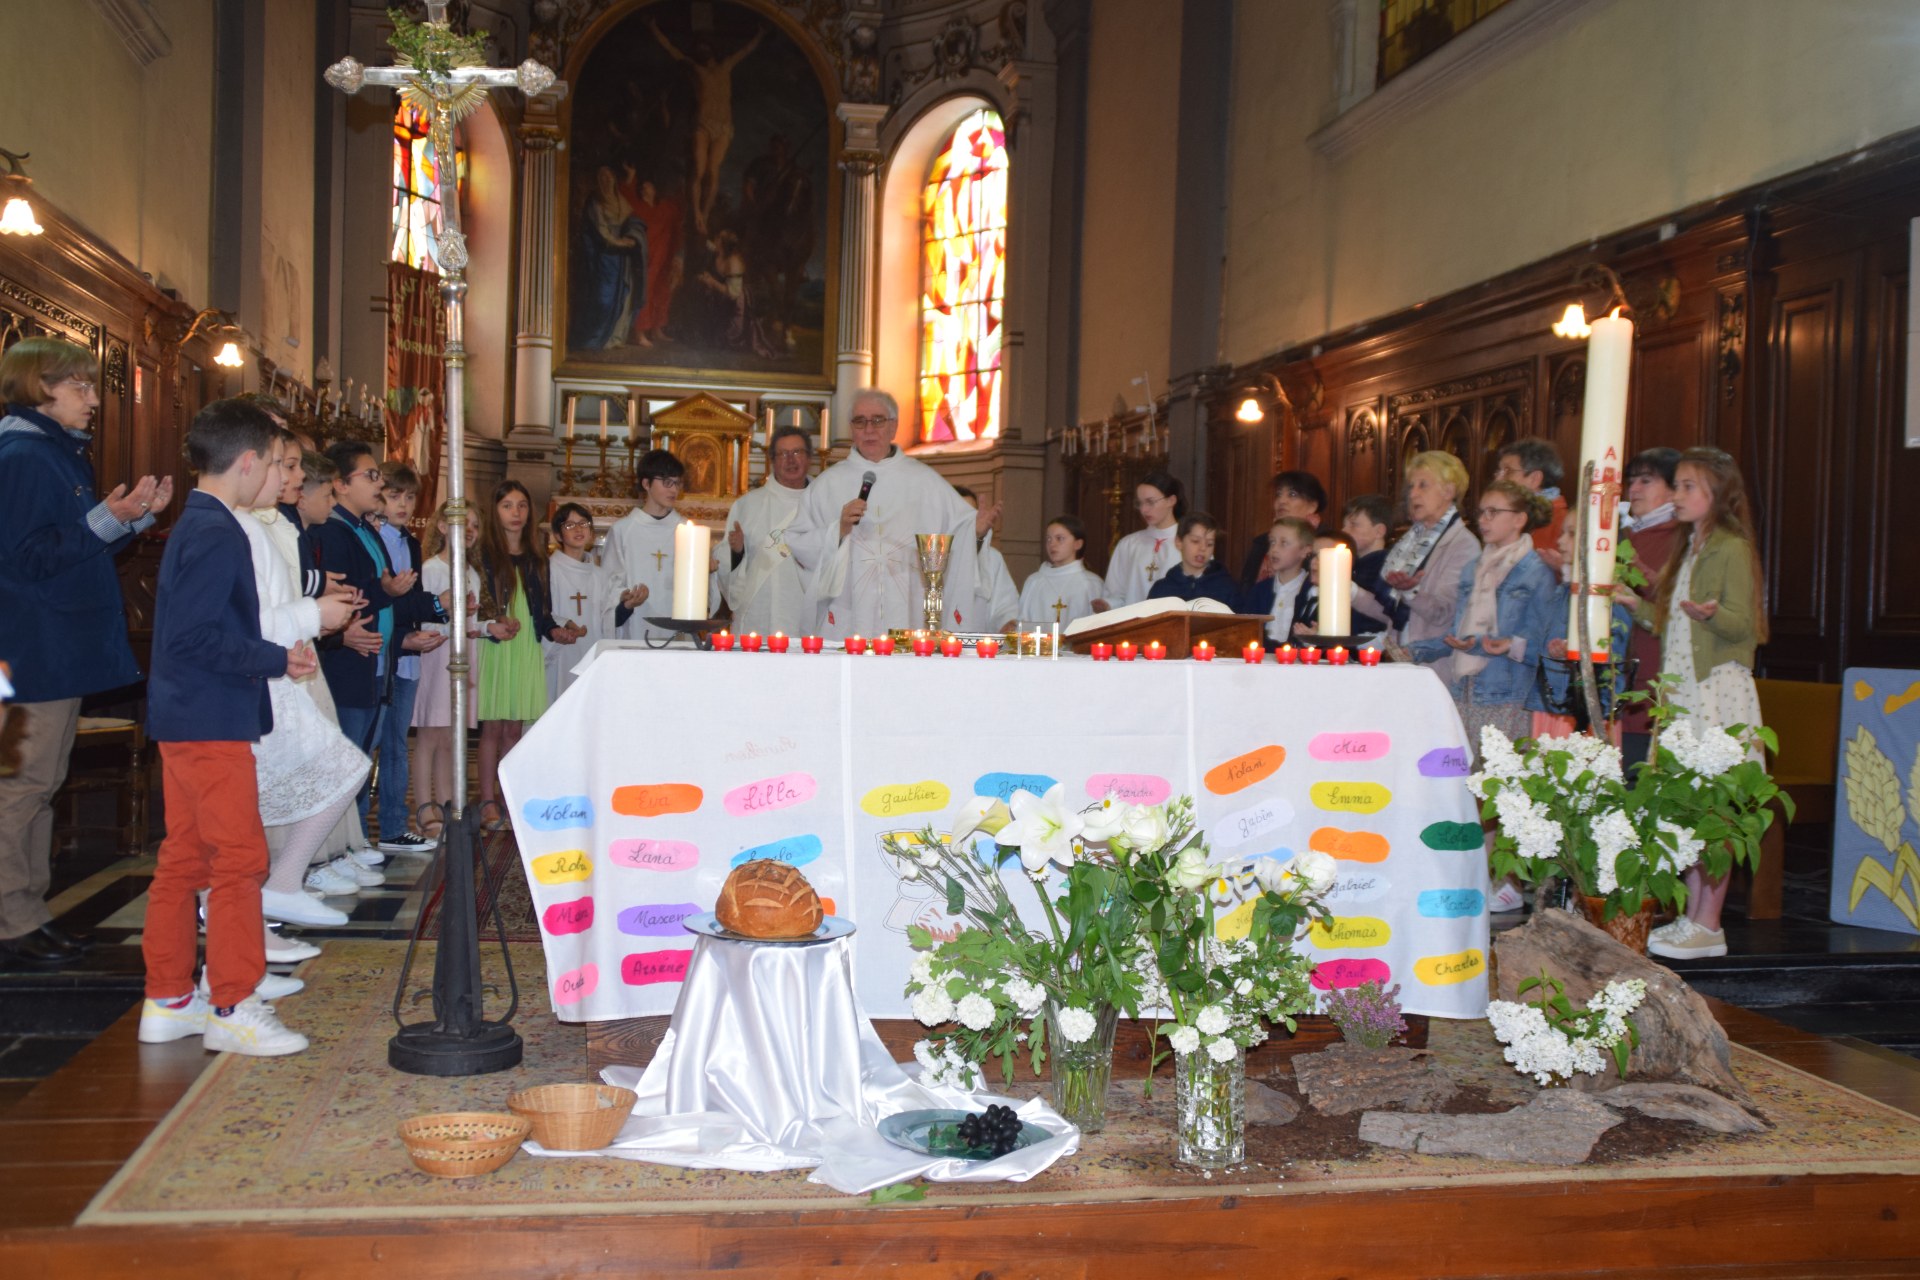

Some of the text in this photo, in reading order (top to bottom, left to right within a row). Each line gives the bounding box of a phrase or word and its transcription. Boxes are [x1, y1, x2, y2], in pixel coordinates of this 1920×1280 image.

[1604, 446, 1617, 461] A
[1328, 784, 1373, 806] Emma
[540, 804, 588, 821] Nolan
